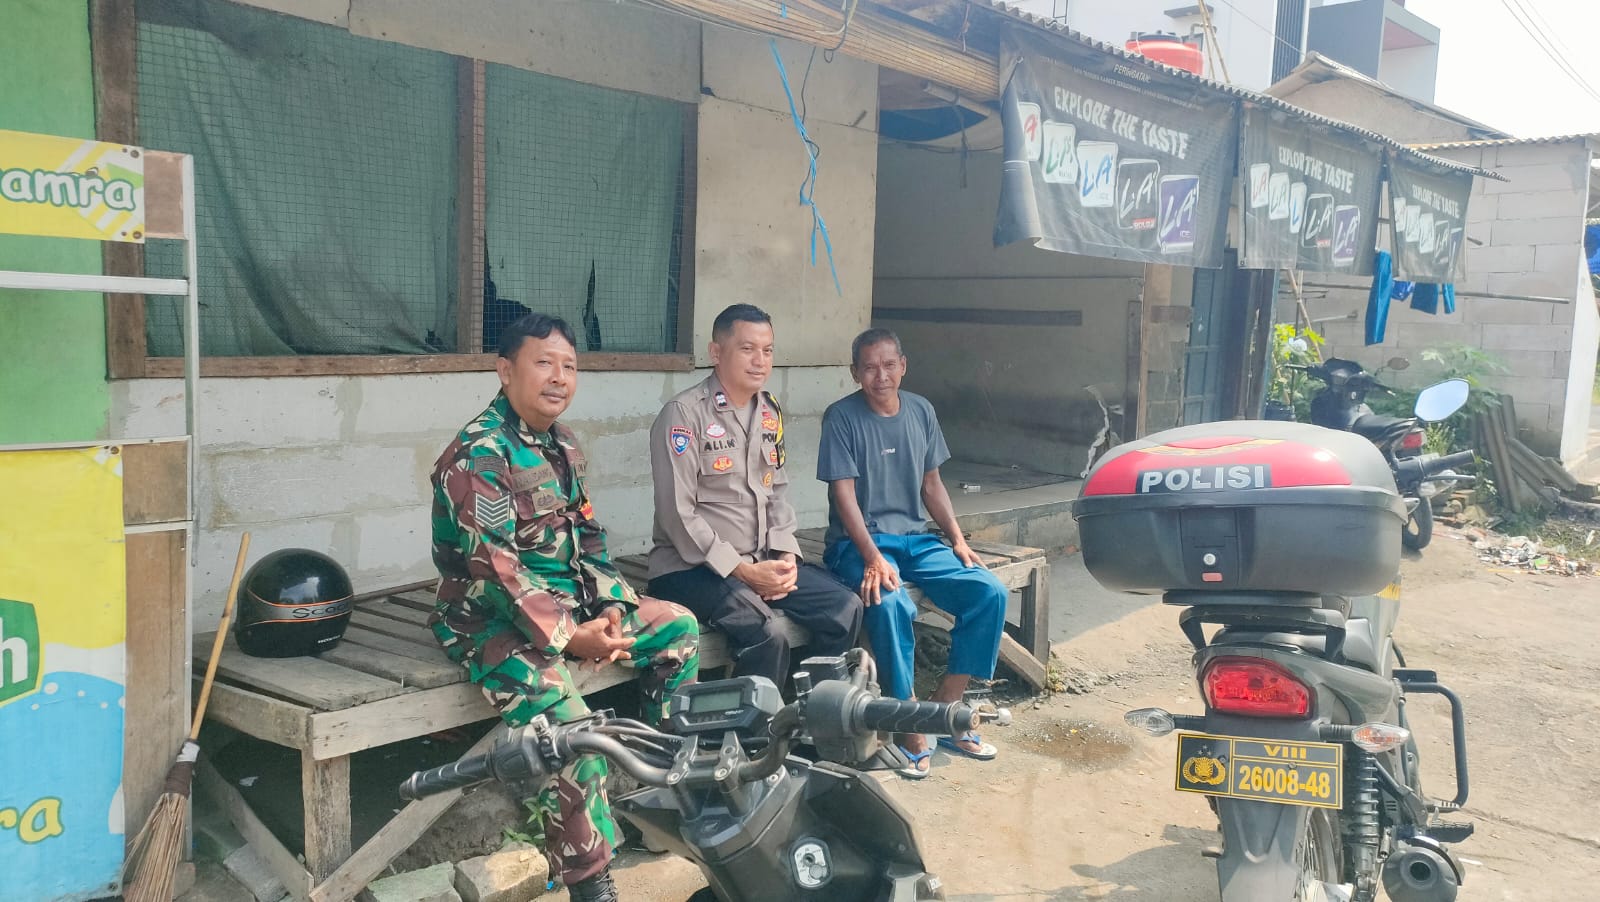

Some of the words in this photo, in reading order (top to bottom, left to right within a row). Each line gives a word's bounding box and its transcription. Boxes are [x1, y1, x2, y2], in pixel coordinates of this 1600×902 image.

[1054, 86, 1110, 130] EXPLORE
[1112, 108, 1140, 142] THE
[1142, 119, 1190, 160] TASTE
[0, 167, 136, 212] amra
[1305, 155, 1324, 181] THE
[1324, 163, 1355, 194] TASTE
[1141, 465, 1265, 493] POLISI
[1264, 744, 1307, 760] VIII
[1238, 764, 1331, 799] 26008-48
